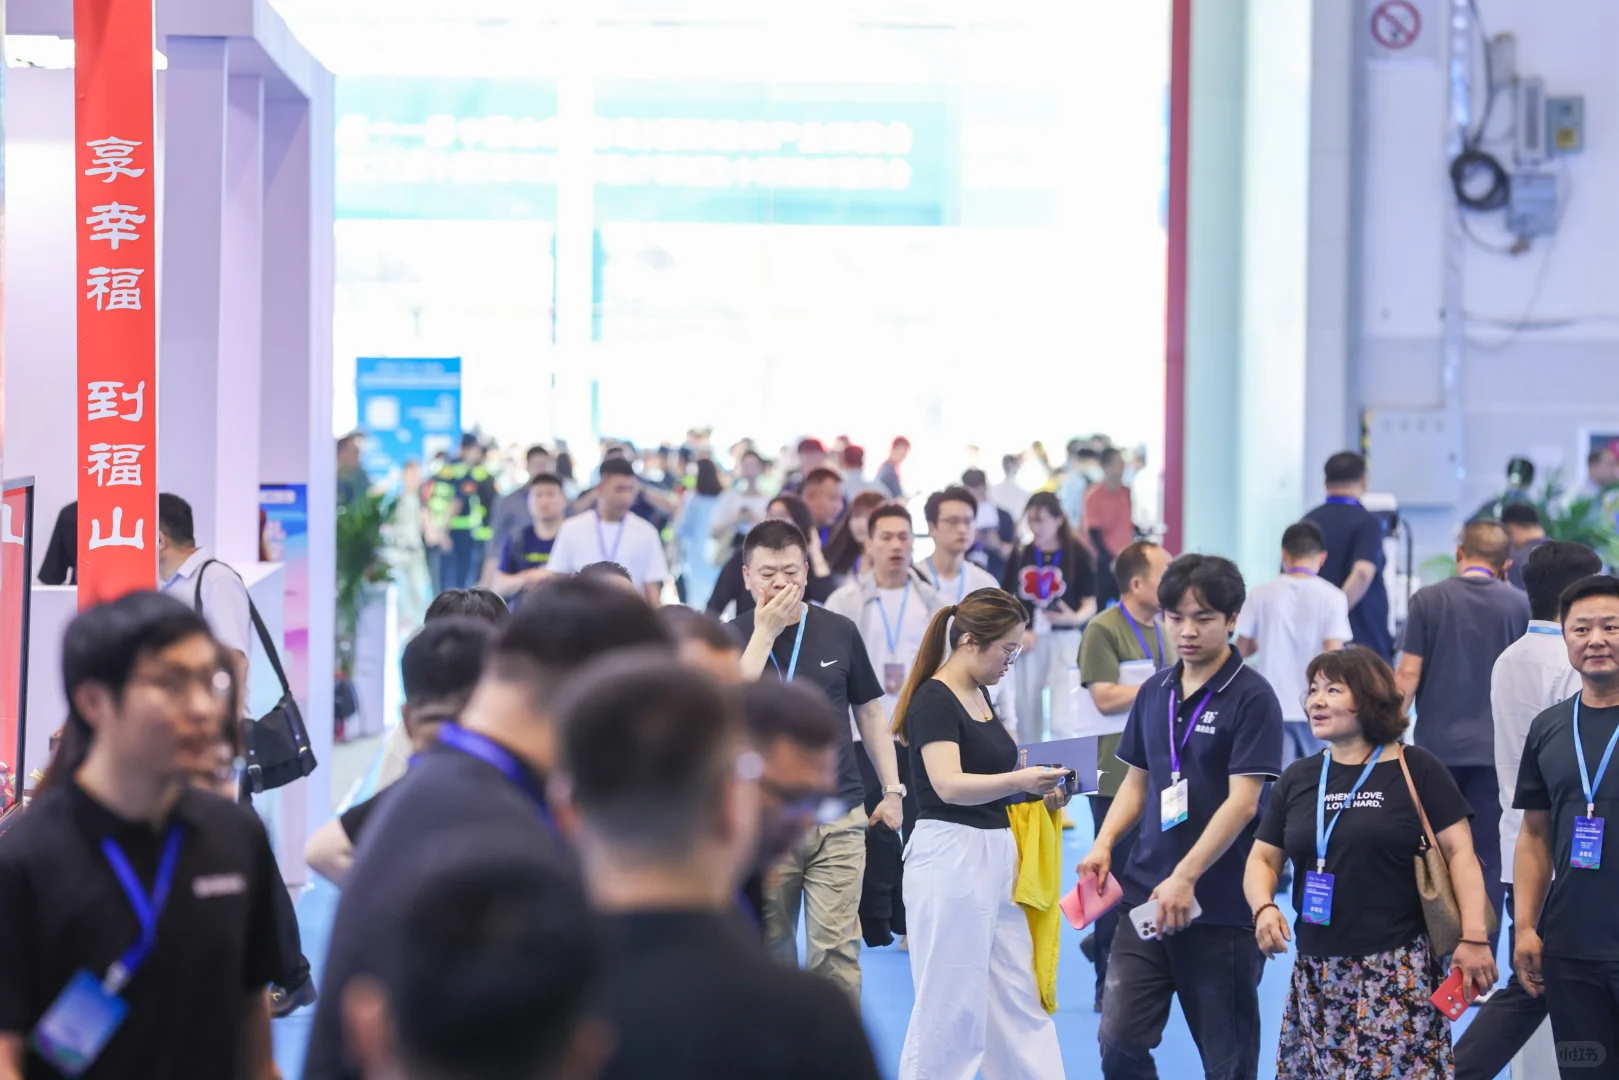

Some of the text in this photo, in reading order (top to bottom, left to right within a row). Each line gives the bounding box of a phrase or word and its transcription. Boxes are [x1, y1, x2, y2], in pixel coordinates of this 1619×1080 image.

[84, 136, 146, 550] 享幸福 到福山
[1357, 791, 1385, 801] LOVE,
[1353, 800, 1382, 808] HARD.
